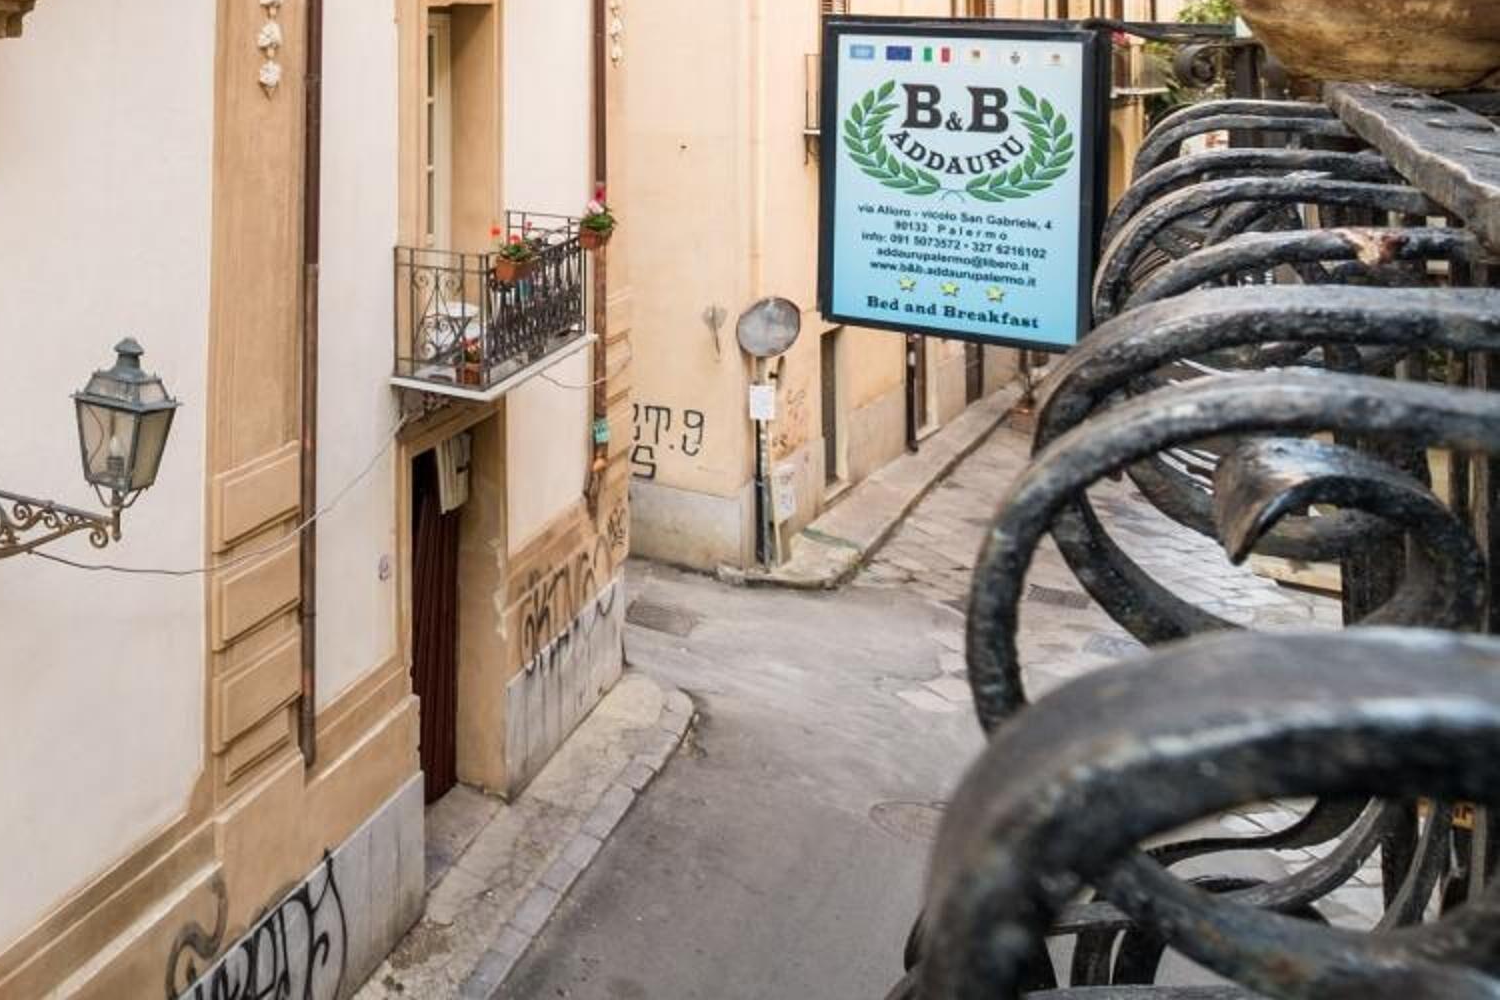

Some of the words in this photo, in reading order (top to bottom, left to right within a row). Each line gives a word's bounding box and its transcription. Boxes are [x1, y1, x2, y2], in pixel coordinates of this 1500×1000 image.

[901, 83, 1009, 133] B&B
[887, 130, 1026, 175] ADDAURU
[858, 205, 874, 214] via
[922, 210, 957, 221] vicolo
[960, 212, 983, 224] San
[1044, 220, 1052, 230] 4
[890, 233, 909, 245] 091
[971, 241, 993, 253] 327
[867, 295, 899, 311] Bed
[904, 303, 937, 316] and
[943, 305, 1039, 329] Breakfast
